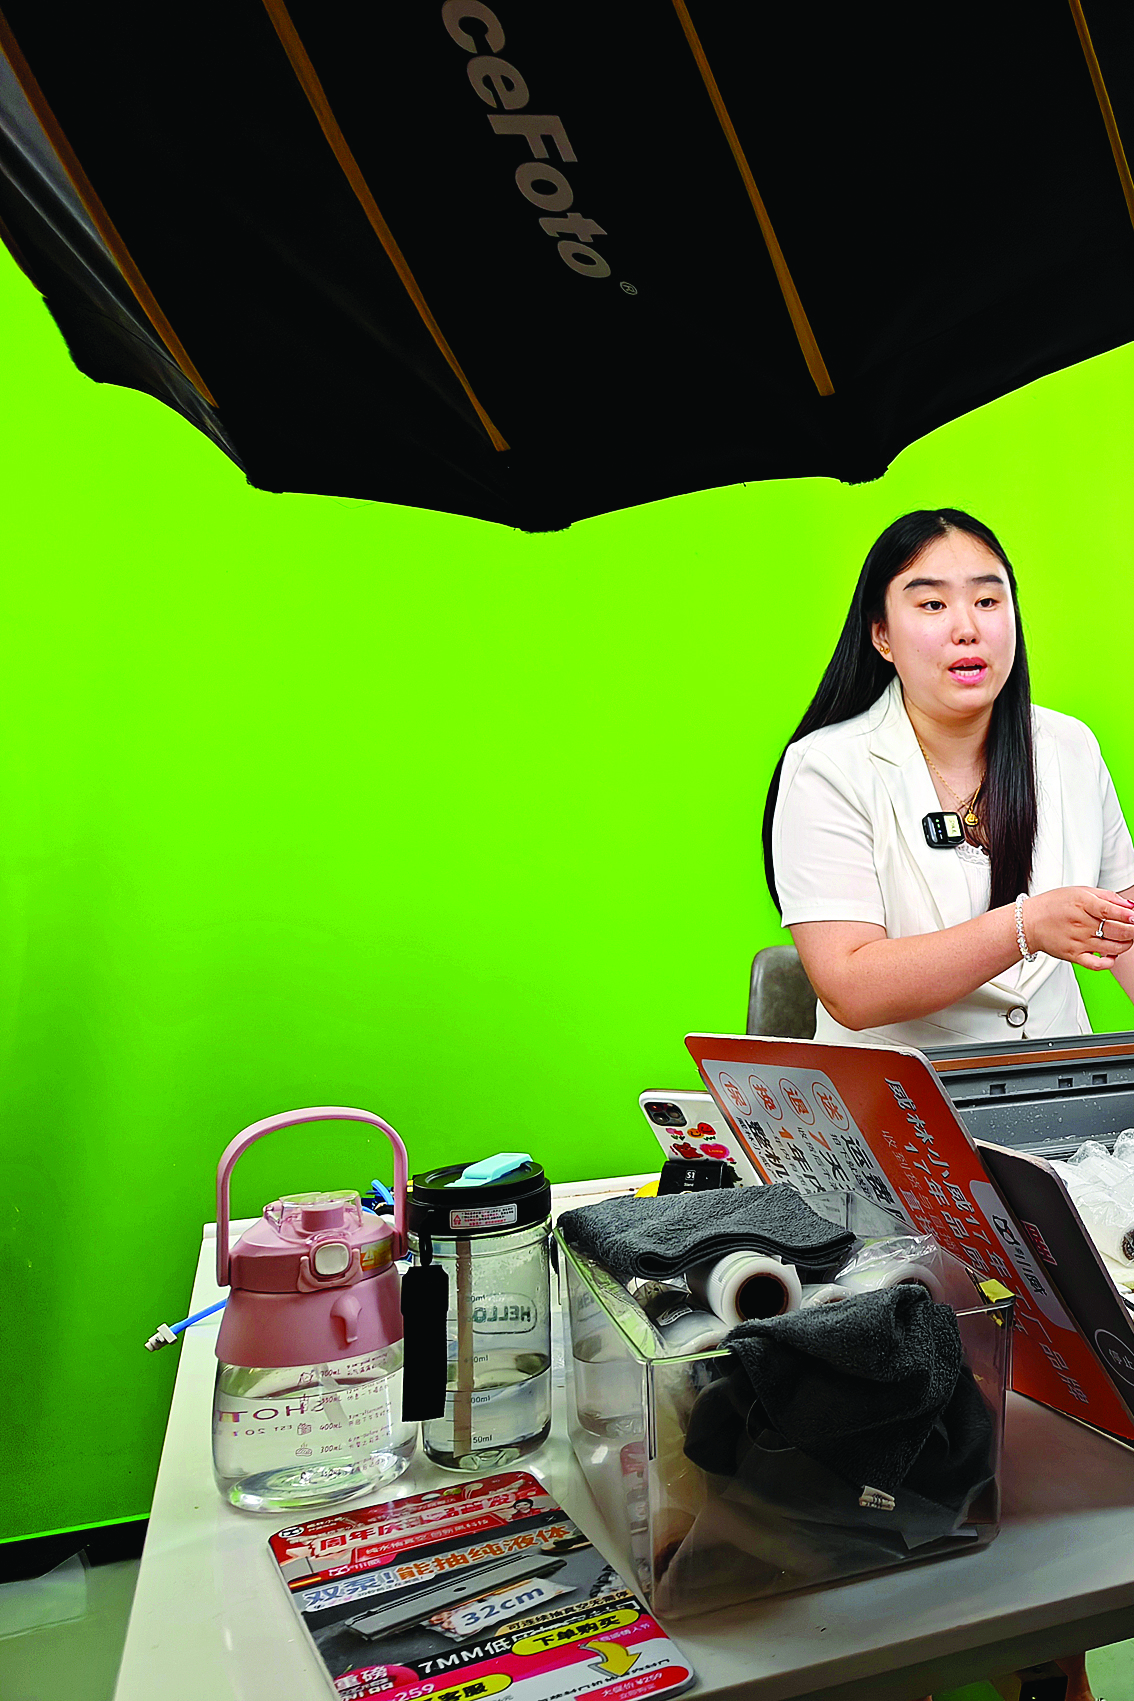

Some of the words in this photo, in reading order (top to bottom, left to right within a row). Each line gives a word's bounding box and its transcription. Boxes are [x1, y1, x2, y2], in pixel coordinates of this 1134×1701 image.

[721, 1079, 749, 1108] 保
[750, 1082, 780, 1112] 换
[781, 1086, 812, 1117] 退
[814, 1091, 846, 1122] 送
[878, 1129, 963, 1258] 收到货与直播
[460, 1587, 546, 1626] 32cm
[535, 1614, 621, 1649] 下单购买
[390, 1681, 437, 1701] 259
